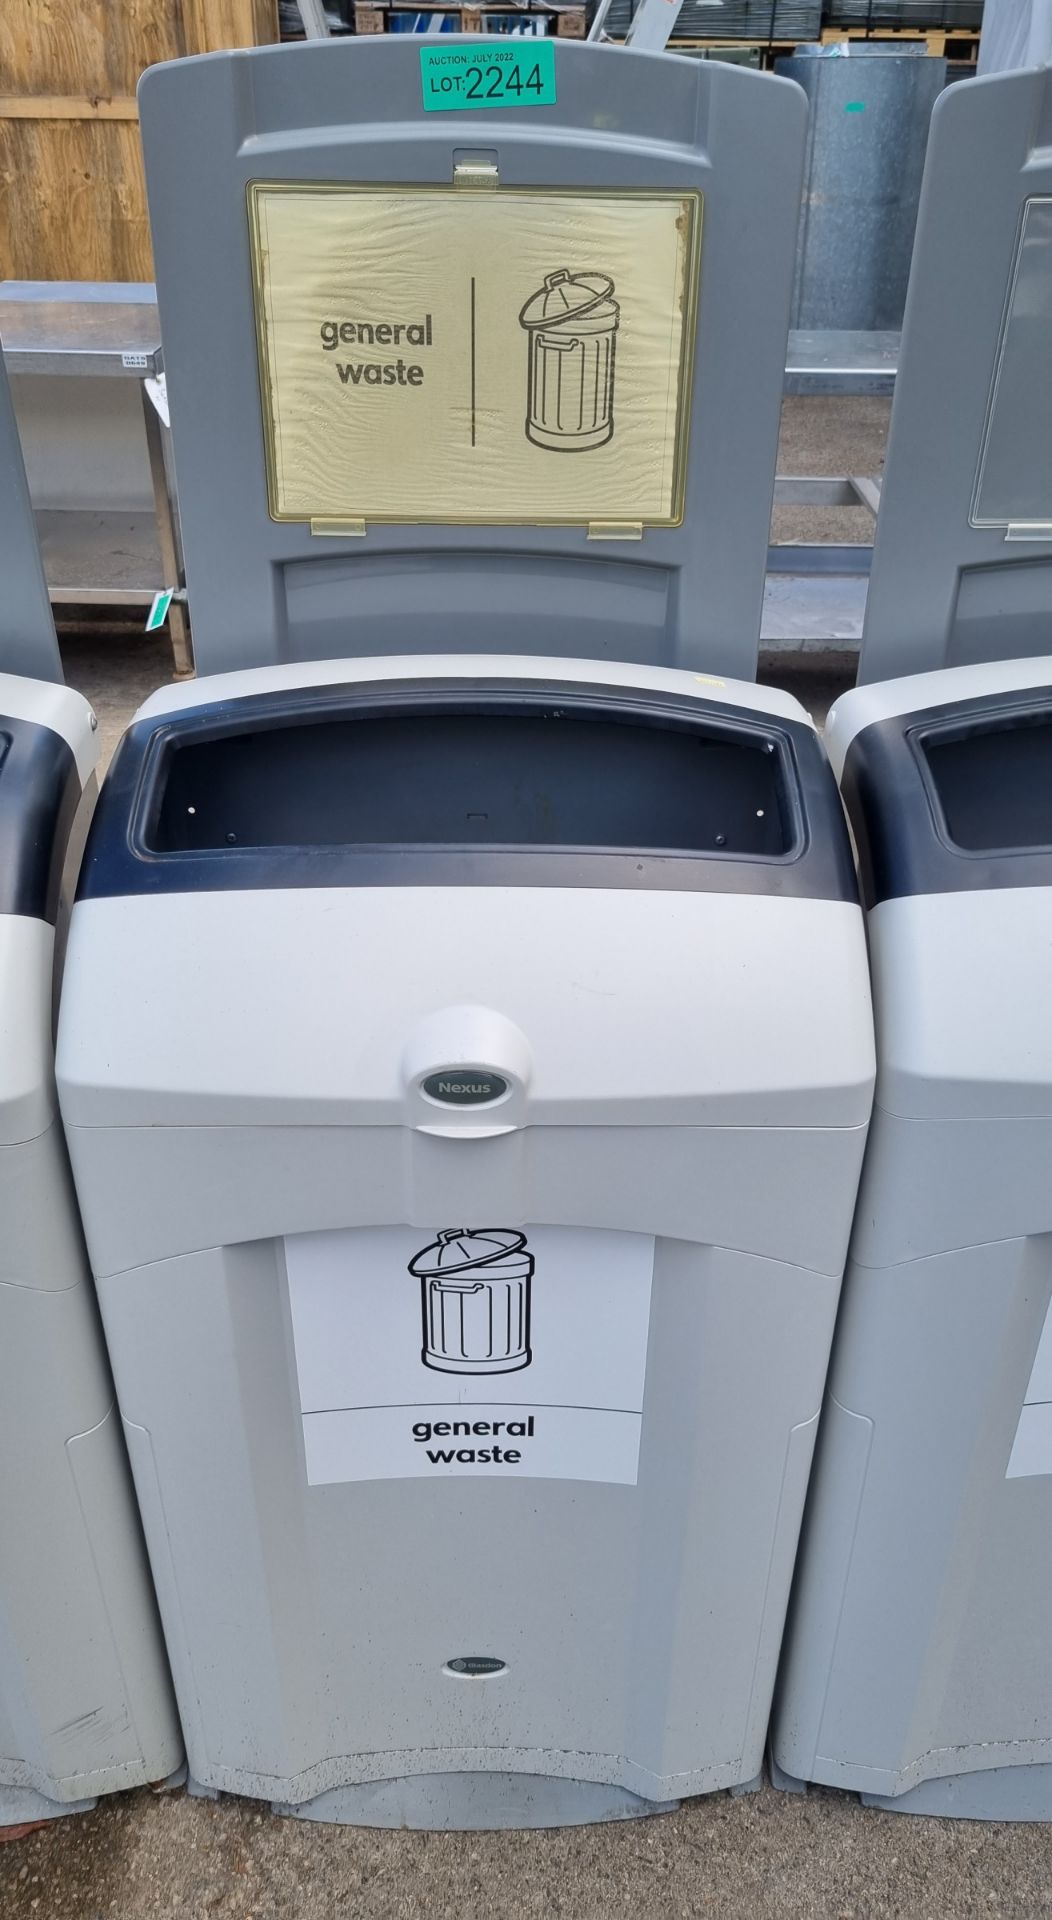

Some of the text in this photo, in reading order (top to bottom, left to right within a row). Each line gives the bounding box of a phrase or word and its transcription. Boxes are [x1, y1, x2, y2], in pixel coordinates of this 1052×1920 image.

[428, 52, 514, 66] AUCTION: JULY 2022
[430, 63, 544, 99] LOT: 2244
[320, 314, 432, 351] general
[335, 359, 424, 386] waste
[438, 1082, 491, 1093] Nexus
[412, 1415, 534, 1442] general
[426, 1446, 522, 1463] waste
